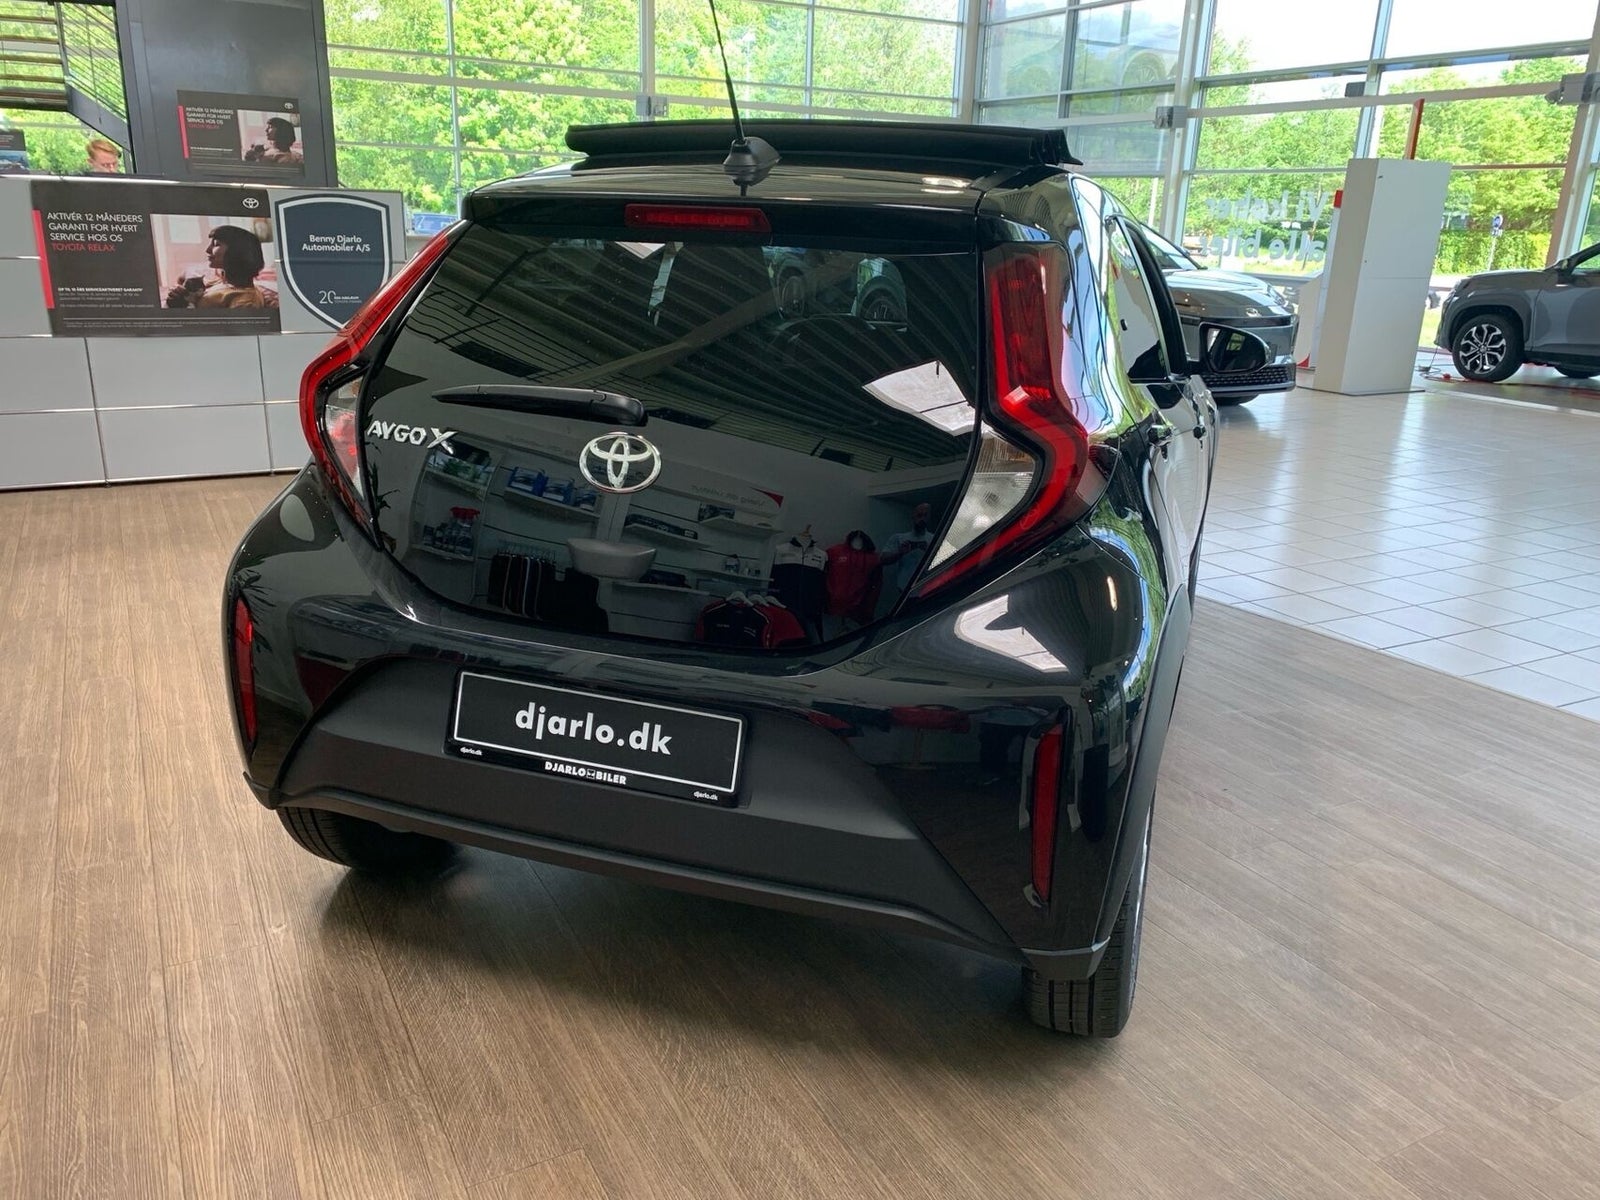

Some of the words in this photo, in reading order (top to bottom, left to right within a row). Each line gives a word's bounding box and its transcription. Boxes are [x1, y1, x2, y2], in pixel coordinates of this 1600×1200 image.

[47, 211, 82, 221] AKTIVÉR
[85, 213, 94, 221] 12
[96, 212, 143, 223] MÅNEDERS
[48, 222, 88, 231] GARANTI
[90, 223, 109, 232] FOR
[111, 224, 138, 233] HVERT
[50, 232, 85, 241] SERVICE
[87, 233, 107, 242] HOS
[109, 234, 123, 242] OS
[309, 234, 336, 245] Benny
[336, 234, 362, 246] Djarlo
[52, 242, 85, 251] TOYOTA
[88, 243, 116, 252] RELAX
[302, 243, 354, 252] Automobiler
[355, 244, 371, 253] A/S
[367, 420, 427, 445] AYGO
[427, 427, 458, 455] X
[515, 702, 672, 755] djarlo.dk
[544, 761, 586, 777] DJARLO
[595, 770, 627, 785] BILER
